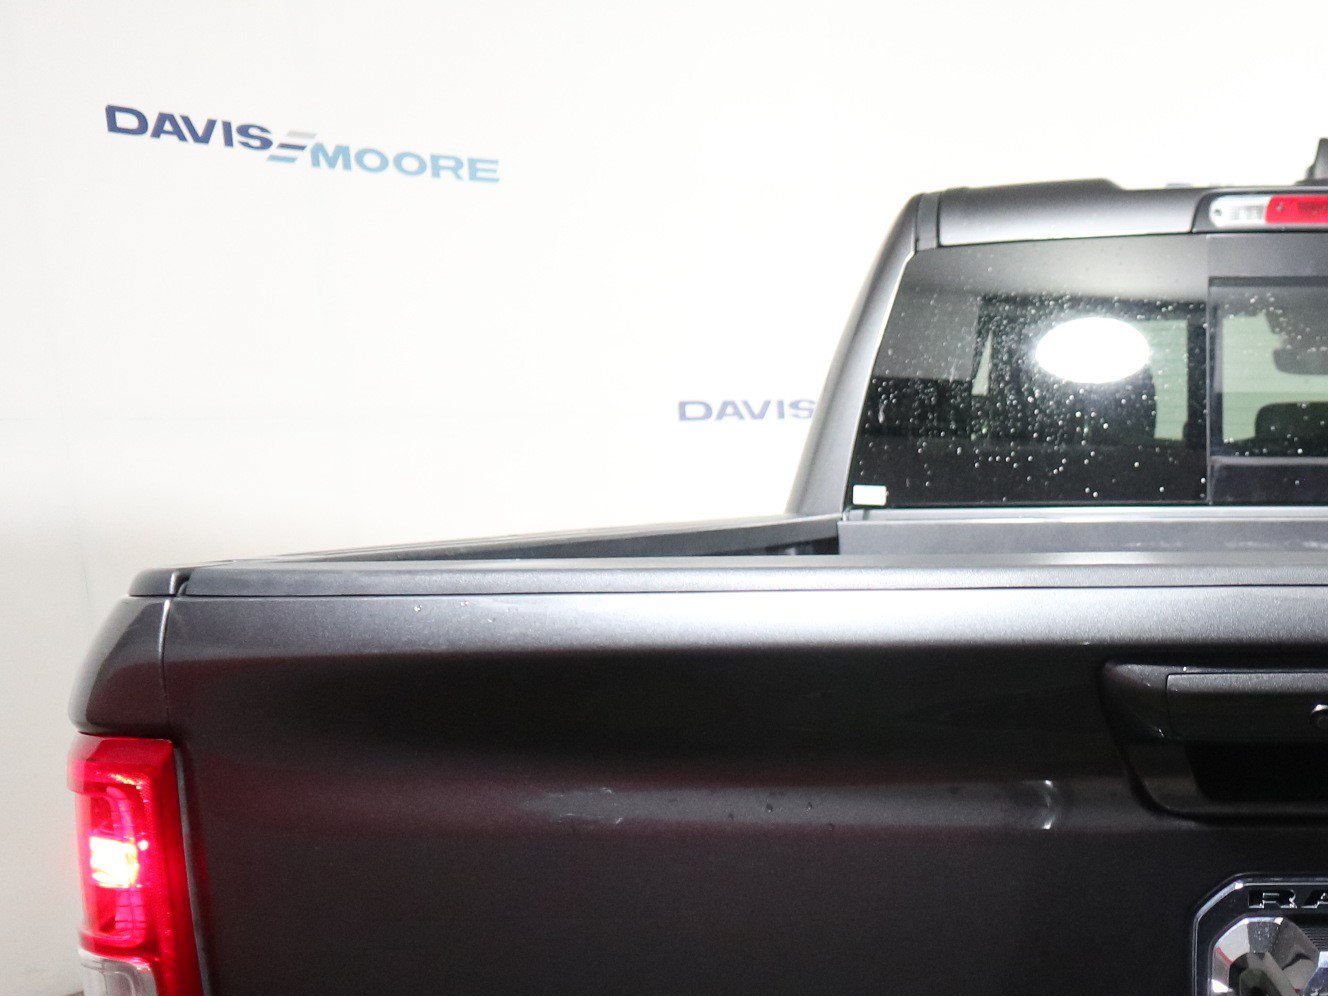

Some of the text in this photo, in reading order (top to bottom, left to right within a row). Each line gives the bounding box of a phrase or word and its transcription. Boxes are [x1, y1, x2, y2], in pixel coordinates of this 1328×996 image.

[105, 104, 500, 183] DAVIS MOORE
[678, 399, 817, 421] DAVIS
